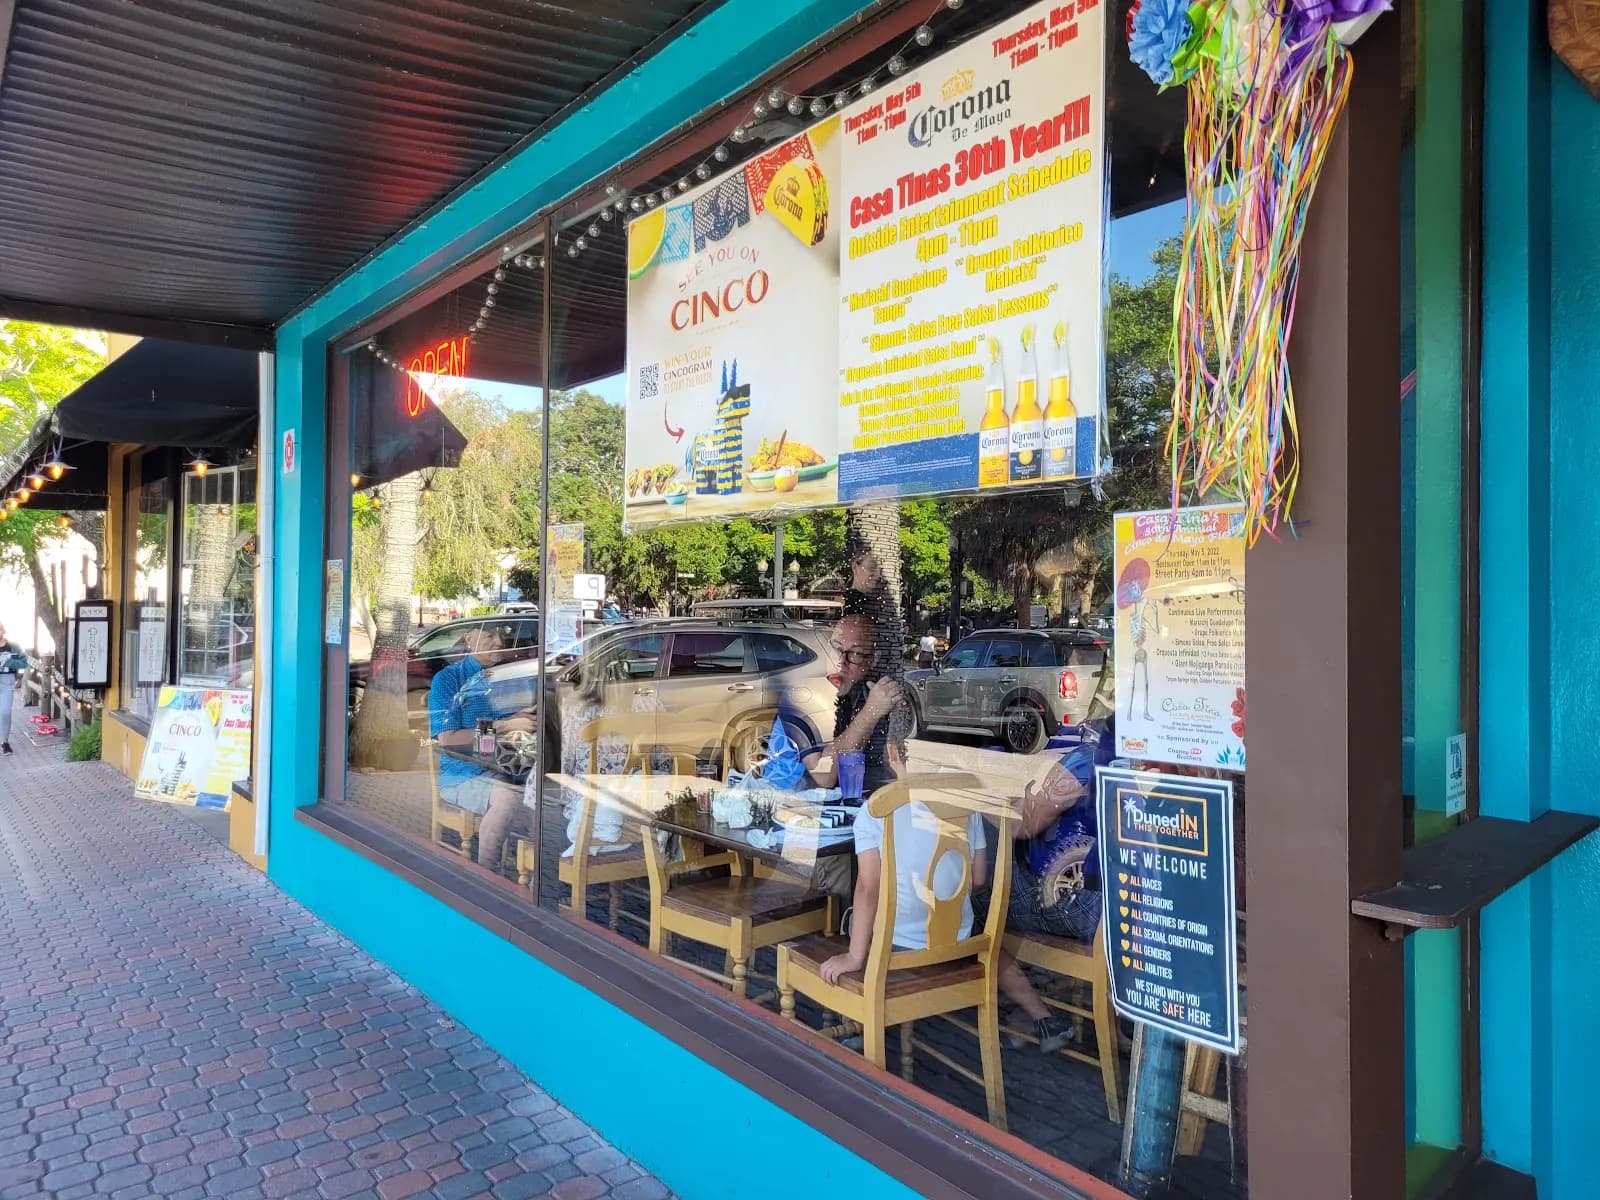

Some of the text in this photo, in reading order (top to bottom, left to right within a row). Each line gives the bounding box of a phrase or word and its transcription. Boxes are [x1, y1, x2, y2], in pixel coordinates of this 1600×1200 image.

[992, 17, 1047, 57] Thursday,
[1050, 2, 1076, 28] May
[1010, 42, 1039, 69] 11am
[1047, 22, 1079, 51] 11pm
[885, 91, 904, 108] May
[905, 81, 922, 103] 5th
[856, 123, 878, 145] 11am
[883, 109, 907, 133] 11pm
[908, 78, 1011, 149] Corona
[951, 108, 1012, 142] De Mayo
[849, 187, 893, 229] Casa
[896, 162, 951, 210] Tinas
[954, 135, 1006, 187] 30th
[773, 181, 804, 221] Corona
[848, 149, 1092, 260] Outside Entertainment Schedule
[916, 232, 948, 262] 4pm
[959, 215, 998, 248] 11pm
[1013, 222, 1083, 260] Folklorico
[709, 247, 735, 265] YOU
[740, 246, 760, 264] ON
[891, 266, 948, 298] Guadalupe
[669, 268, 770, 331] CINCO
[908, 320, 937, 344] Salsa
[938, 310, 963, 335] Free
[964, 303, 996, 328] Salsa
[663, 359, 713, 382] CINCOGRAM
[1011, 430, 1041, 444] Corona
[1043, 426, 1072, 440] Corona
[1136, 512, 1169, 527] Casa
[1124, 537, 1152, 555] Cinco
[1173, 532, 1204, 547] Mayo
[1155, 569, 1173, 579] Street
[1175, 569, 1190, 580] Party
[1191, 568, 1205, 579] 4pm
[1206, 568, 1212, 577] to
[1183, 559, 1195, 569] Open
[1210, 558, 1216, 566] to
[1195, 608, 1206, 617] Live
[1161, 697, 1190, 713] Casa
[169, 723, 202, 737] CINCO
[1166, 734, 1209, 746] Sponsored by
[1176, 753, 1202, 762] Brothers
[1133, 822, 1199, 841] THIS TOGETHER
[1120, 848, 1207, 879] WE WELCOME
[1130, 875, 1162, 892] ALL RACES
[1131, 891, 1174, 911] ALL RELIGIONS
[1131, 908, 1208, 937] ALL COUNTRIES OF ORIGIN
[1131, 925, 1214, 956] ALL SEXUAL ORIENTATIONS
[1132, 942, 1172, 963] ALL GENDERS
[1133, 958, 1173, 980] ALL ABILITIES
[1134, 978, 1200, 1008] WE STAND WITH YOU
[1125, 988, 1212, 1028] YOU ARE SAFE HERE
